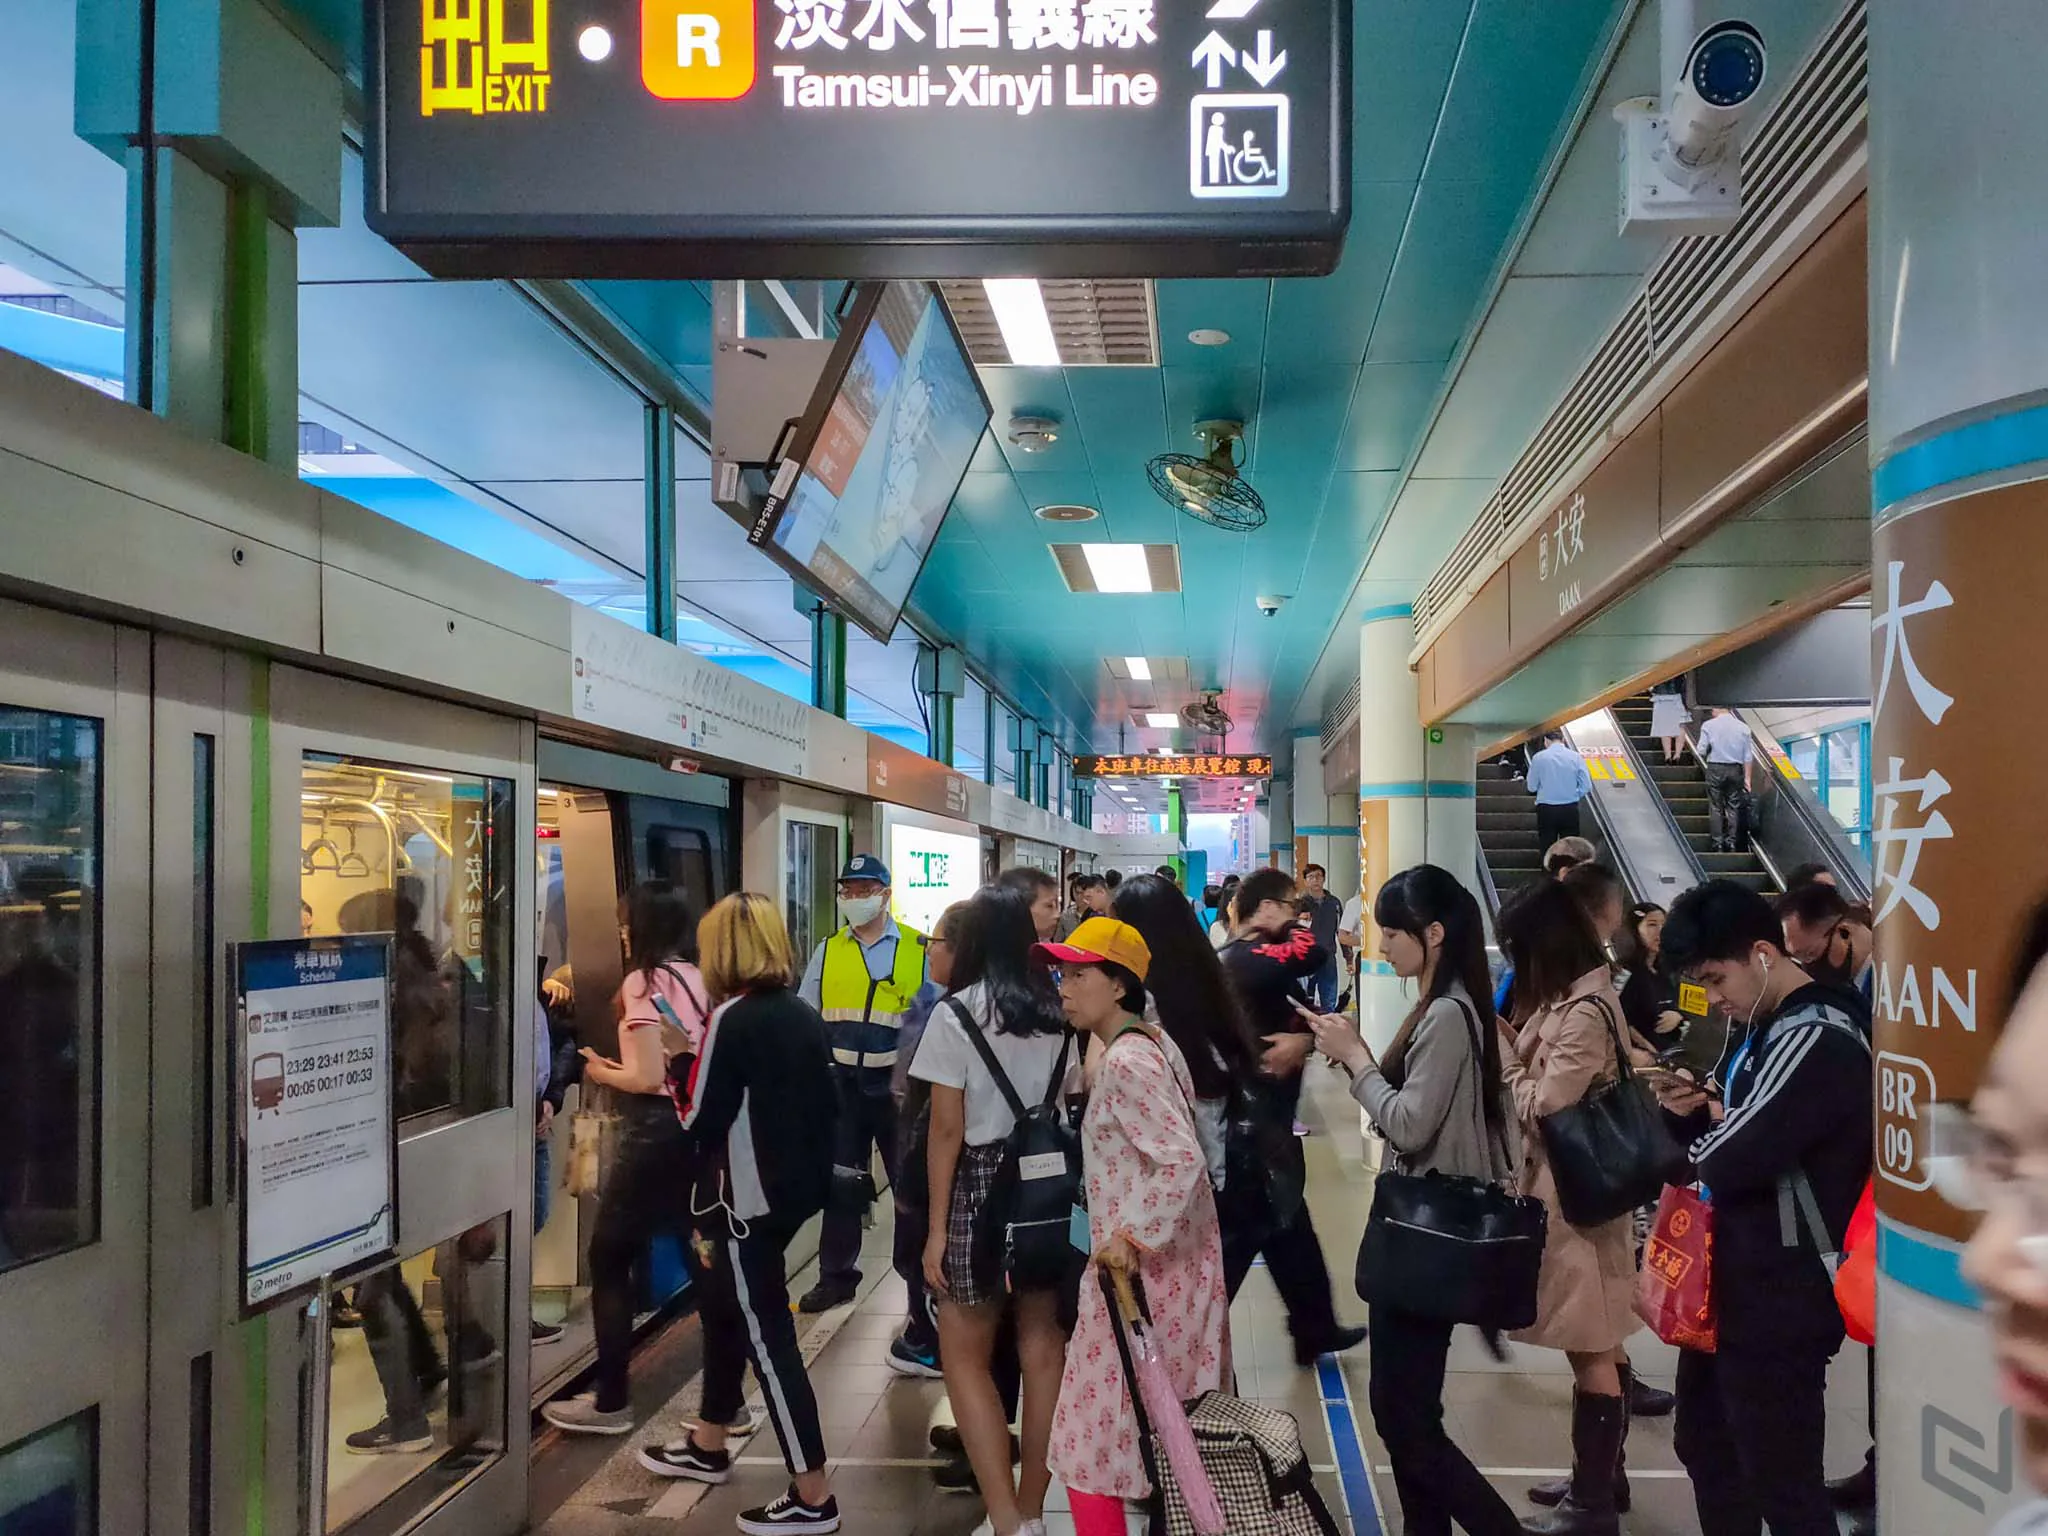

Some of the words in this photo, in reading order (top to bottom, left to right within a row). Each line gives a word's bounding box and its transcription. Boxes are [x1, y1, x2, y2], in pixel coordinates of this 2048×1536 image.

[676, 13, 721, 67] R
[485, 74, 551, 112] EXIT
[773, 64, 1052, 116] Tamsui-Xinyi
[1065, 64, 1158, 107] Line
[1553, 493, 1585, 576] 大安
[1093, 757, 1241, 775] 本班車往南港展覽館
[1871, 560, 1954, 932] 大安
[300, 971, 337, 984] Schedule
[1872, 960, 1977, 1032] AAN
[286, 1057, 315, 1075] 23:29
[317, 1052, 344, 1069] 23:41
[347, 1046, 374, 1064] 23:53
[286, 1080, 316, 1098] 00:05
[317, 1074, 344, 1092] 00:17
[346, 1067, 373, 1085] 00:33
[1881, 1066, 1918, 1120] BR
[1884, 1122, 1913, 1173] 09
[263, 1271, 293, 1290] metro
